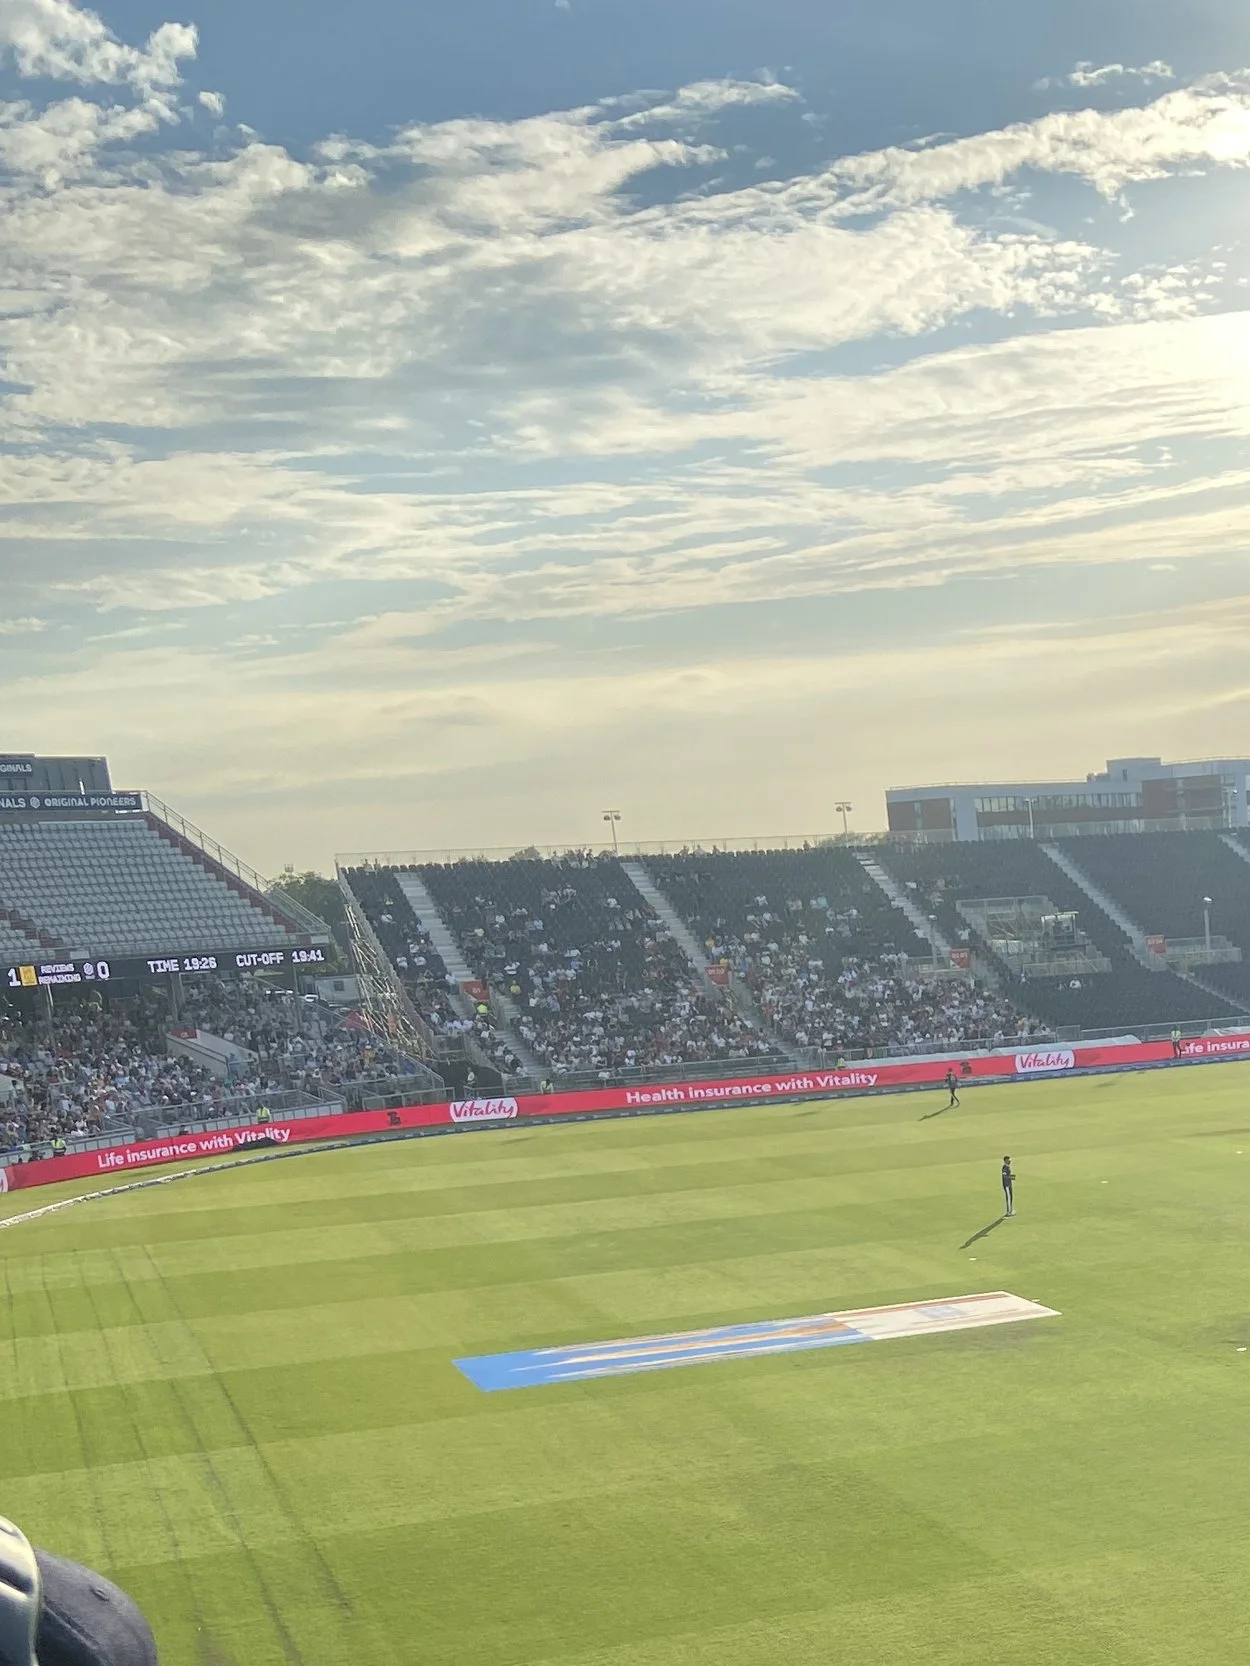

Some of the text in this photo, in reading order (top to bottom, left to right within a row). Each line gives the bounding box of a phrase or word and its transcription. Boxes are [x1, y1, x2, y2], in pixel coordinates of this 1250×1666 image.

[44, 797, 136, 807] ORIGINAL PIONEERS
[147, 957, 217, 973] TIME 19:26
[236, 950, 325, 967] CUT-OFF 19:41
[97, 961, 110, 979] 0
[1019, 1053, 1071, 1070] Vitality
[625, 1072, 878, 1104] Health insurance with Vitality
[453, 1100, 514, 1119] Vitality
[97, 1128, 291, 1168] Life insurance with Vitality
